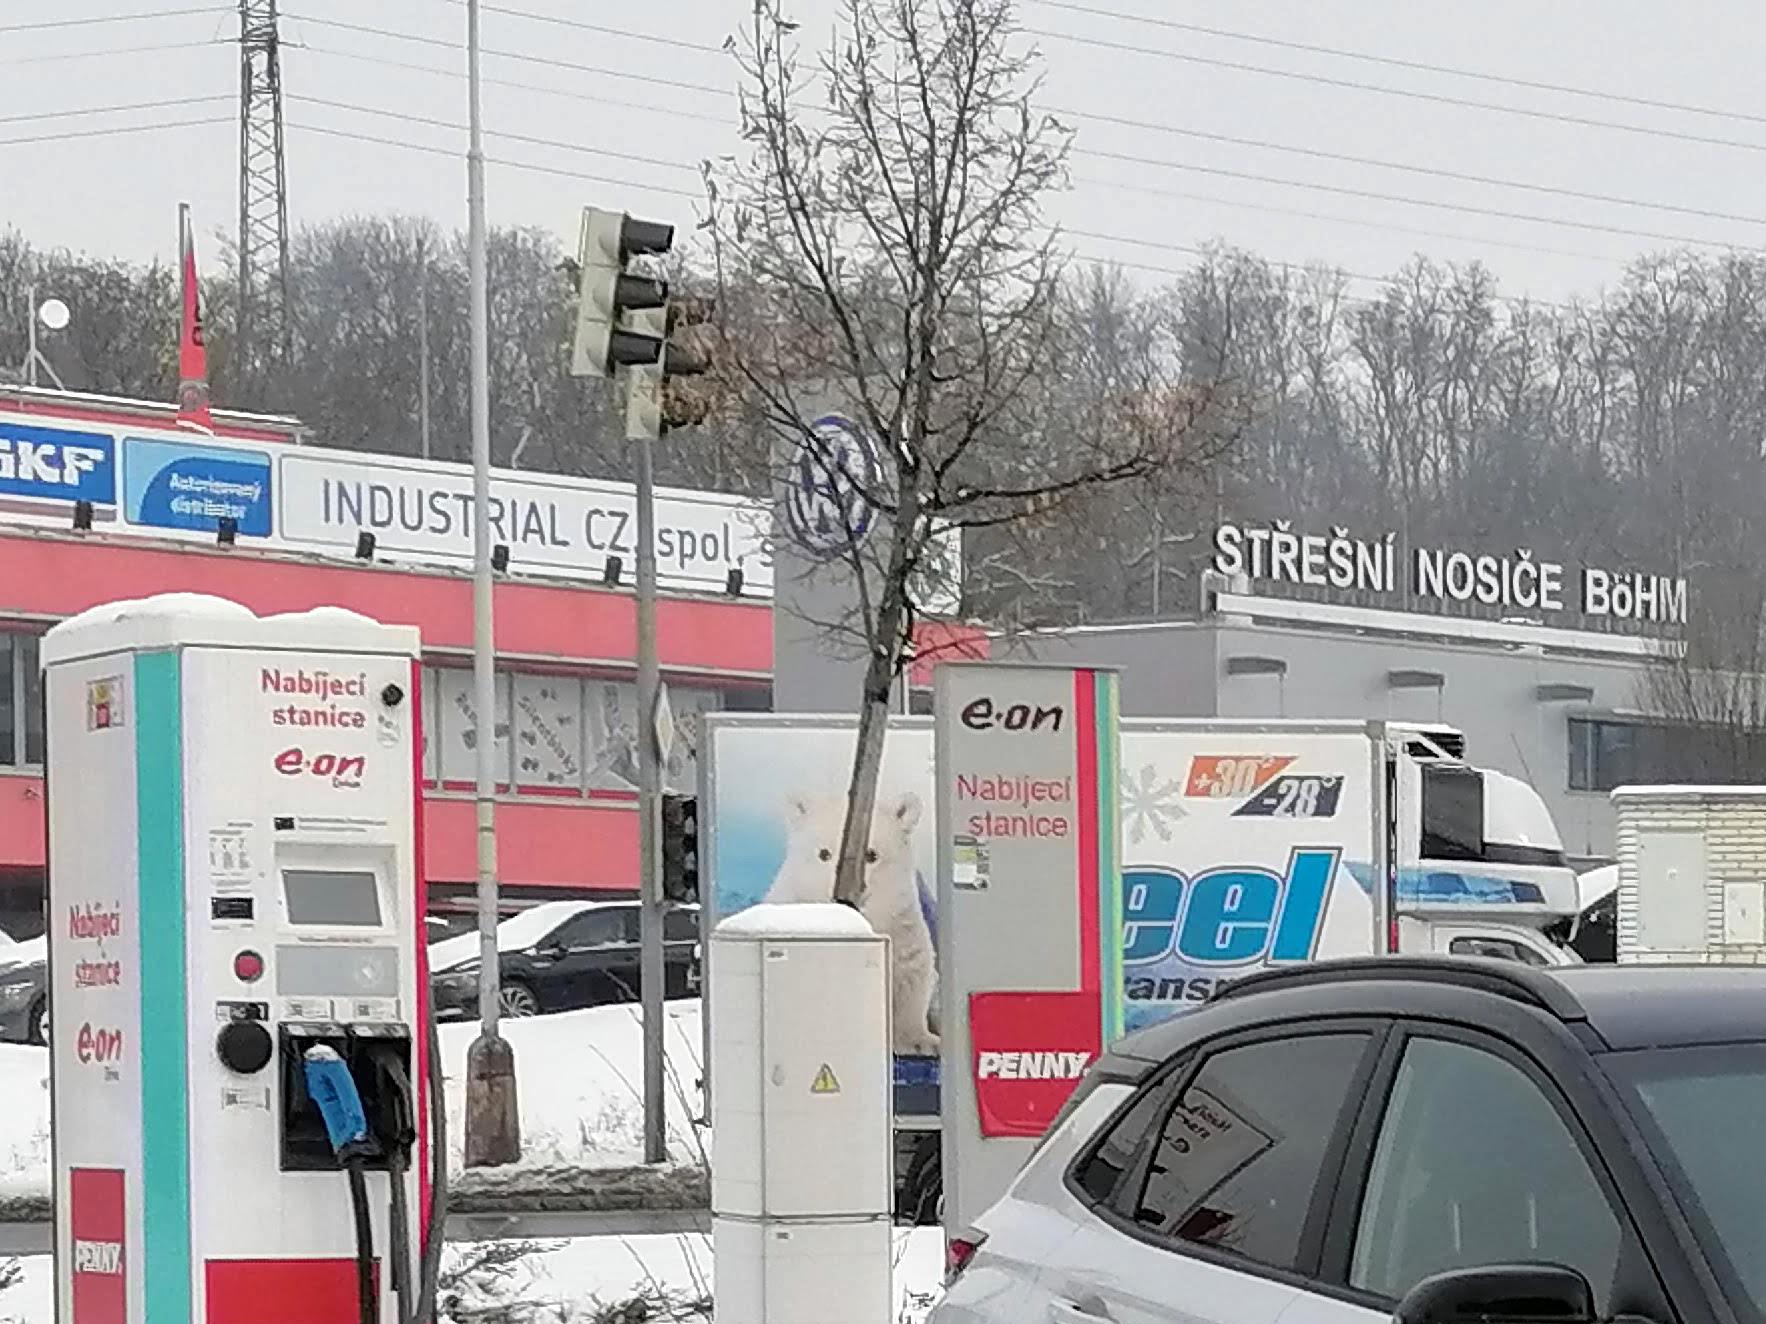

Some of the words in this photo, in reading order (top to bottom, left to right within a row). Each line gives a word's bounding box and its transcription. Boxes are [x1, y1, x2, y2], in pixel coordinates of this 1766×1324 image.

[323, 478, 570, 547] INDUSTRIAL
[1216, 520, 1396, 593] STŘEŠNÍ
[1416, 549, 1564, 611] NOSIČE
[273, 703, 366, 728] stanice
[968, 810, 1068, 837] stanice
